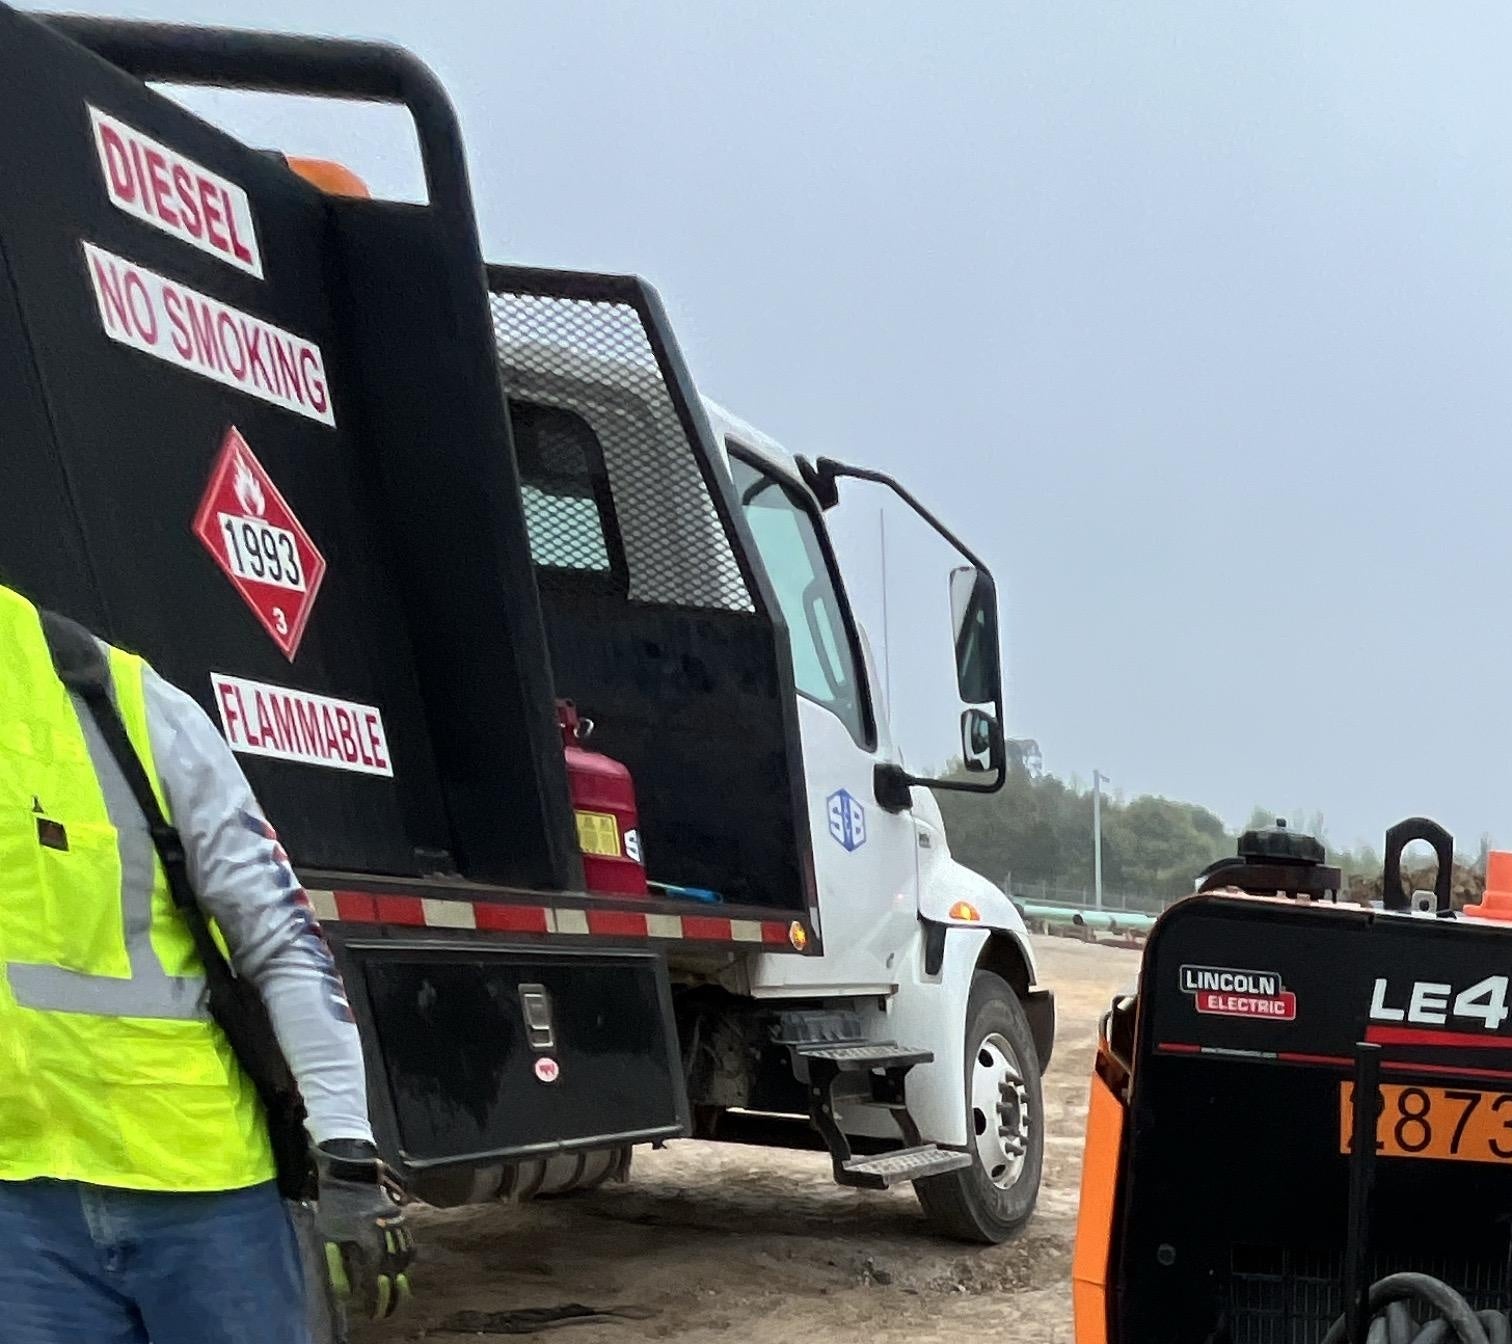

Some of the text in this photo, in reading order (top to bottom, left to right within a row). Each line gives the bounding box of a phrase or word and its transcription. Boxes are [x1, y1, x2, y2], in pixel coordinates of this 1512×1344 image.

[99, 121, 254, 266] DIESEL
[93, 255, 328, 414] NO SMOKING
[225, 518, 301, 586] 1993
[271, 606, 289, 635] 3
[218, 682, 387, 769] FLAMMABLE
[1186, 969, 1275, 996] LINCOLN
[1207, 995, 1286, 1015] ELECTRIC
